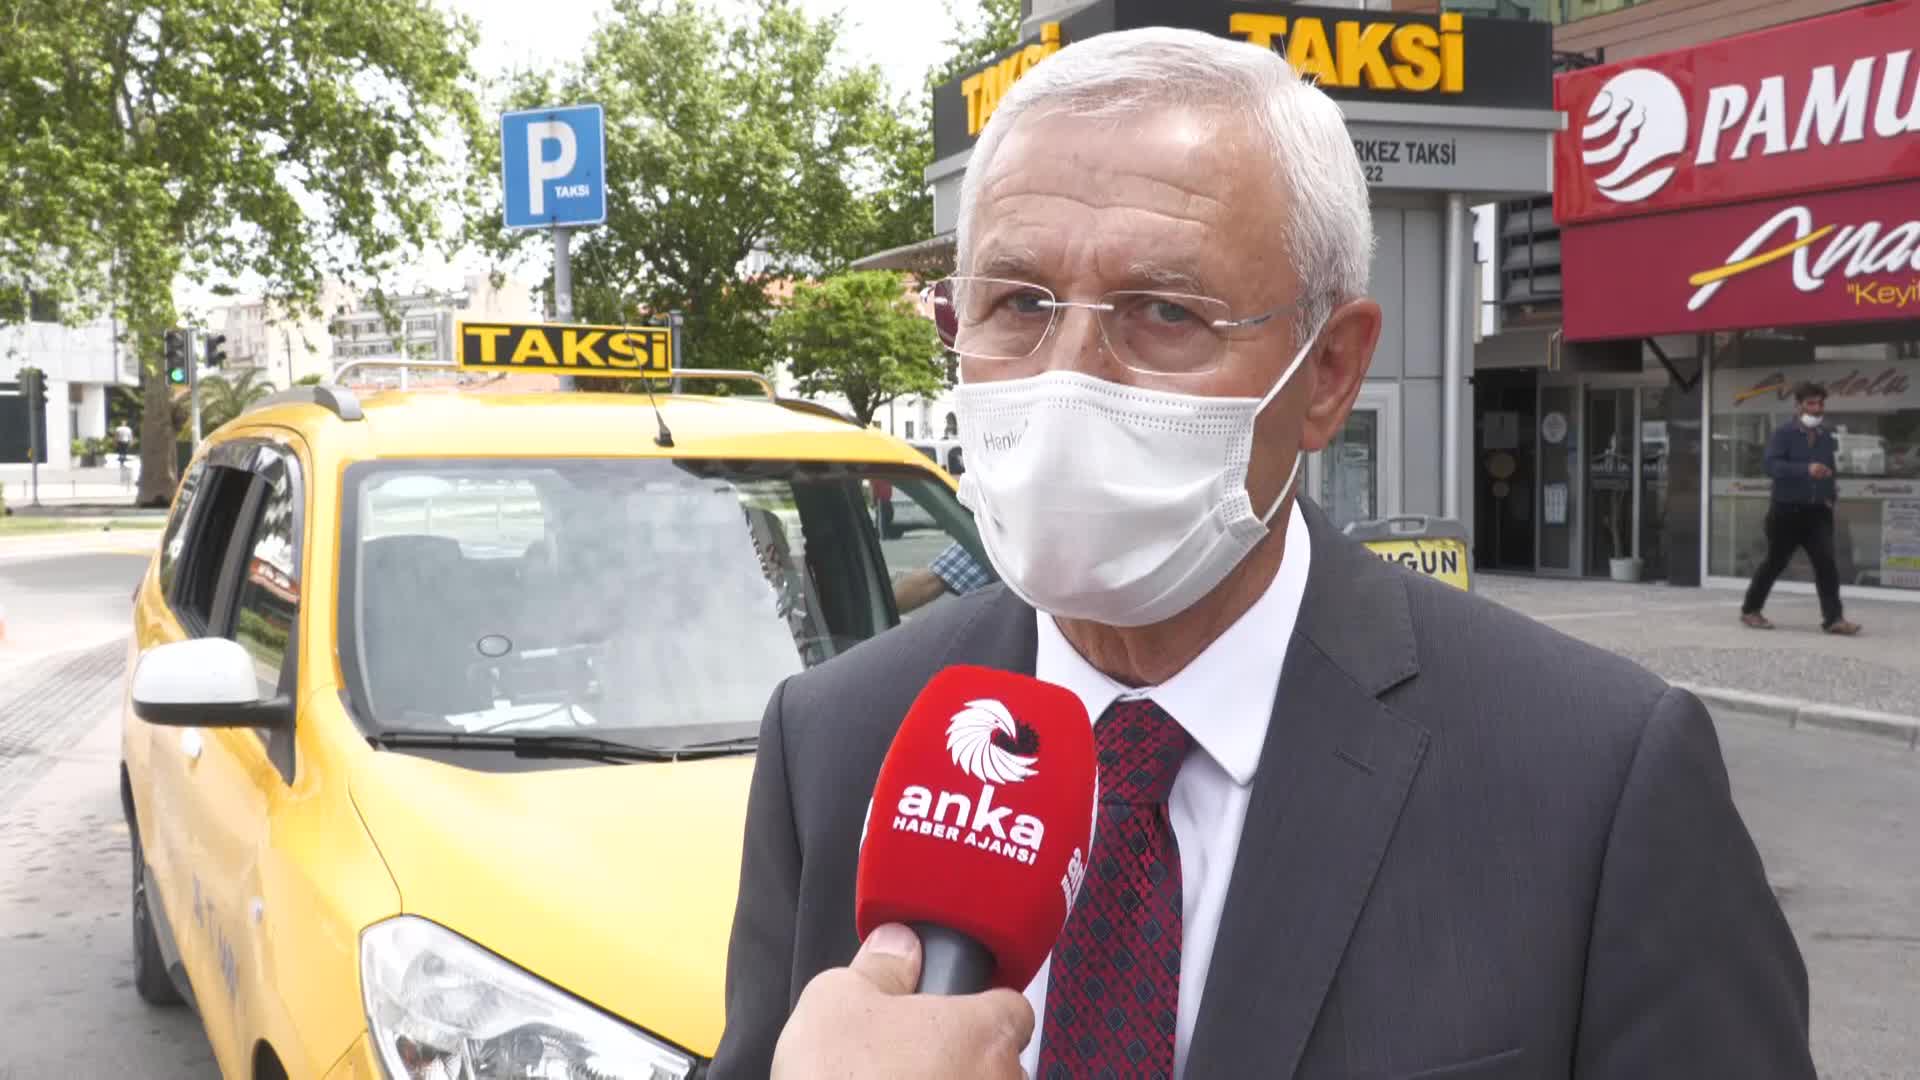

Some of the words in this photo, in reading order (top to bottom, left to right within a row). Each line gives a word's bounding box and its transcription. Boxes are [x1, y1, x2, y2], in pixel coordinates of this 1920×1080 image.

[1695, 49, 1920, 165] PAMU
[527, 120, 577, 215] P
[1847, 279, 1920, 309] "Keyi
[892, 815, 960, 841] HABER
[964, 832, 1037, 866] AJANSI
[898, 783, 1045, 851] anka
